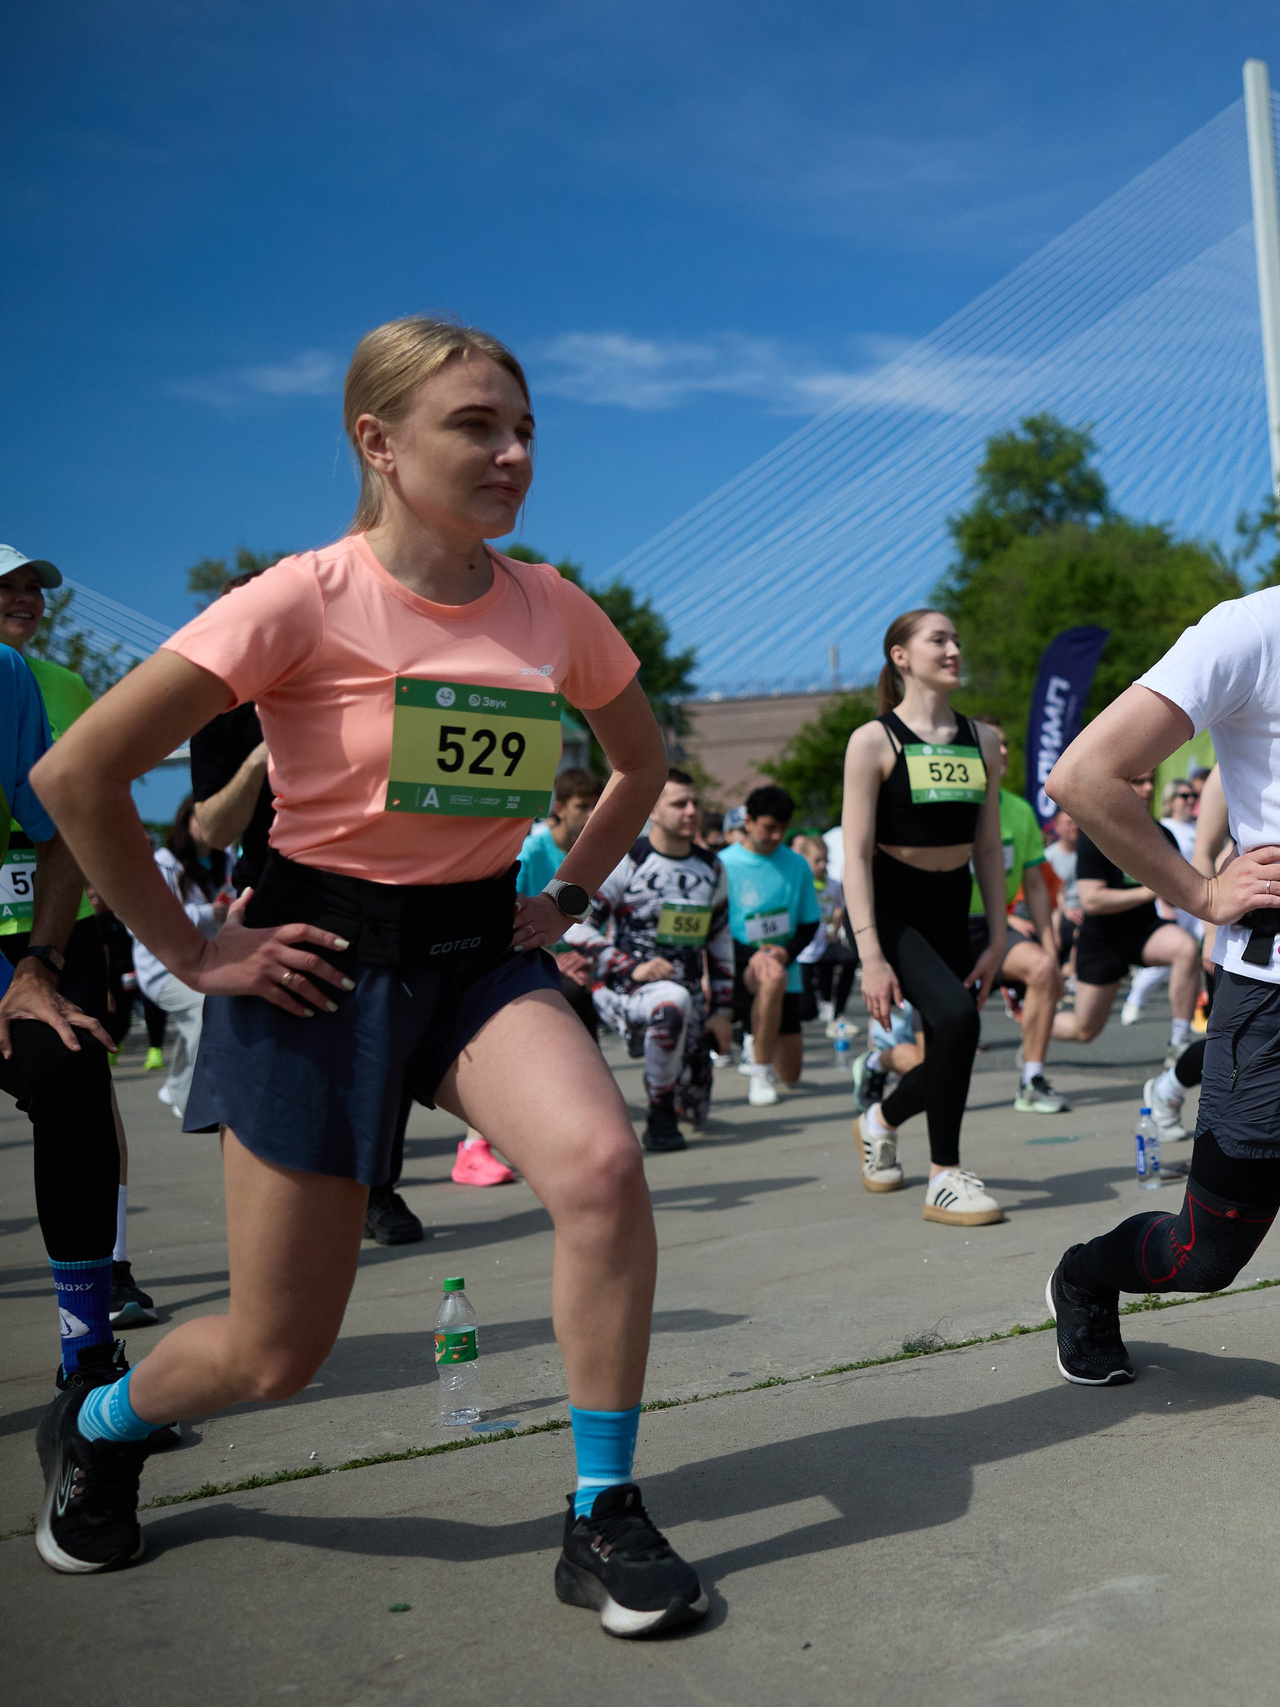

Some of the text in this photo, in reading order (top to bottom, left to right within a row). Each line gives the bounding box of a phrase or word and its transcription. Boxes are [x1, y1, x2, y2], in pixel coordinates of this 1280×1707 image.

[482, 696, 507, 709] Звук
[436, 725, 526, 777] 529
[929, 762, 969, 783] 523
